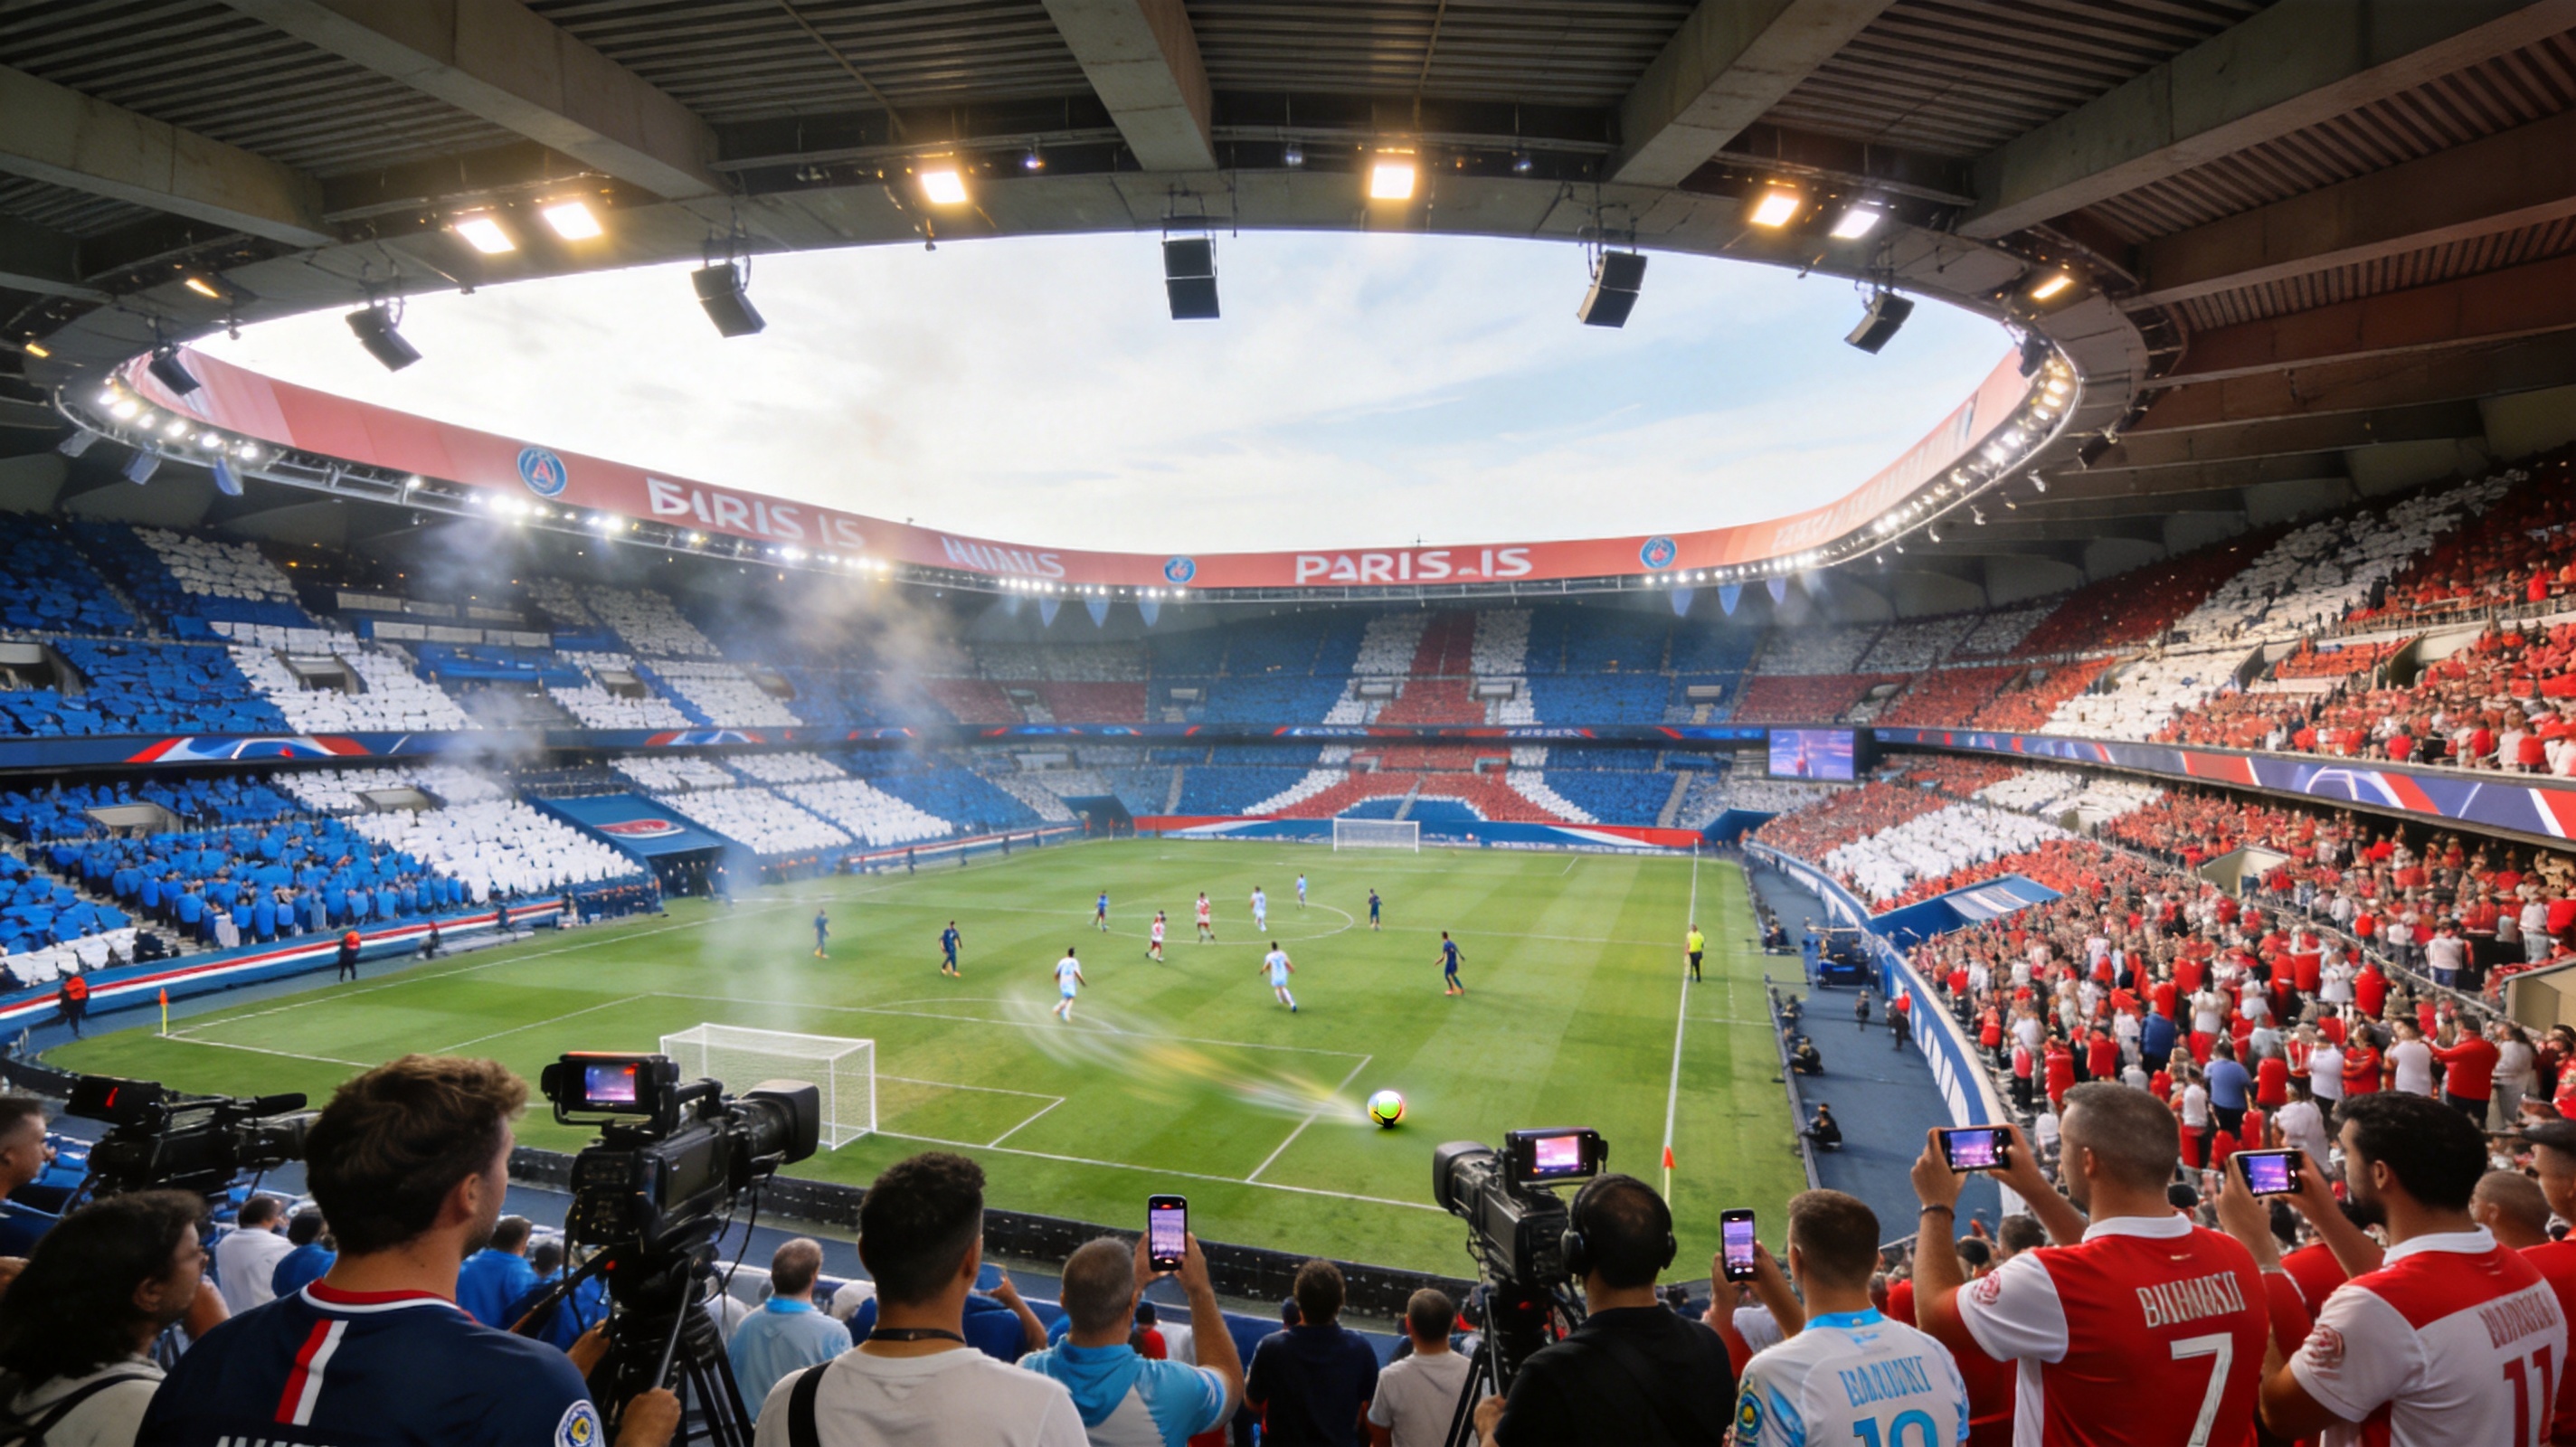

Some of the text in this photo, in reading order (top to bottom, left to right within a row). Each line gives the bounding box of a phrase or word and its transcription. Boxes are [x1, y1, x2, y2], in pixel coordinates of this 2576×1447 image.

[1295, 551, 1452, 584] PARIS
[2170, 1332, 2233, 1447] 7
[2503, 1344, 2552, 1447] 11
